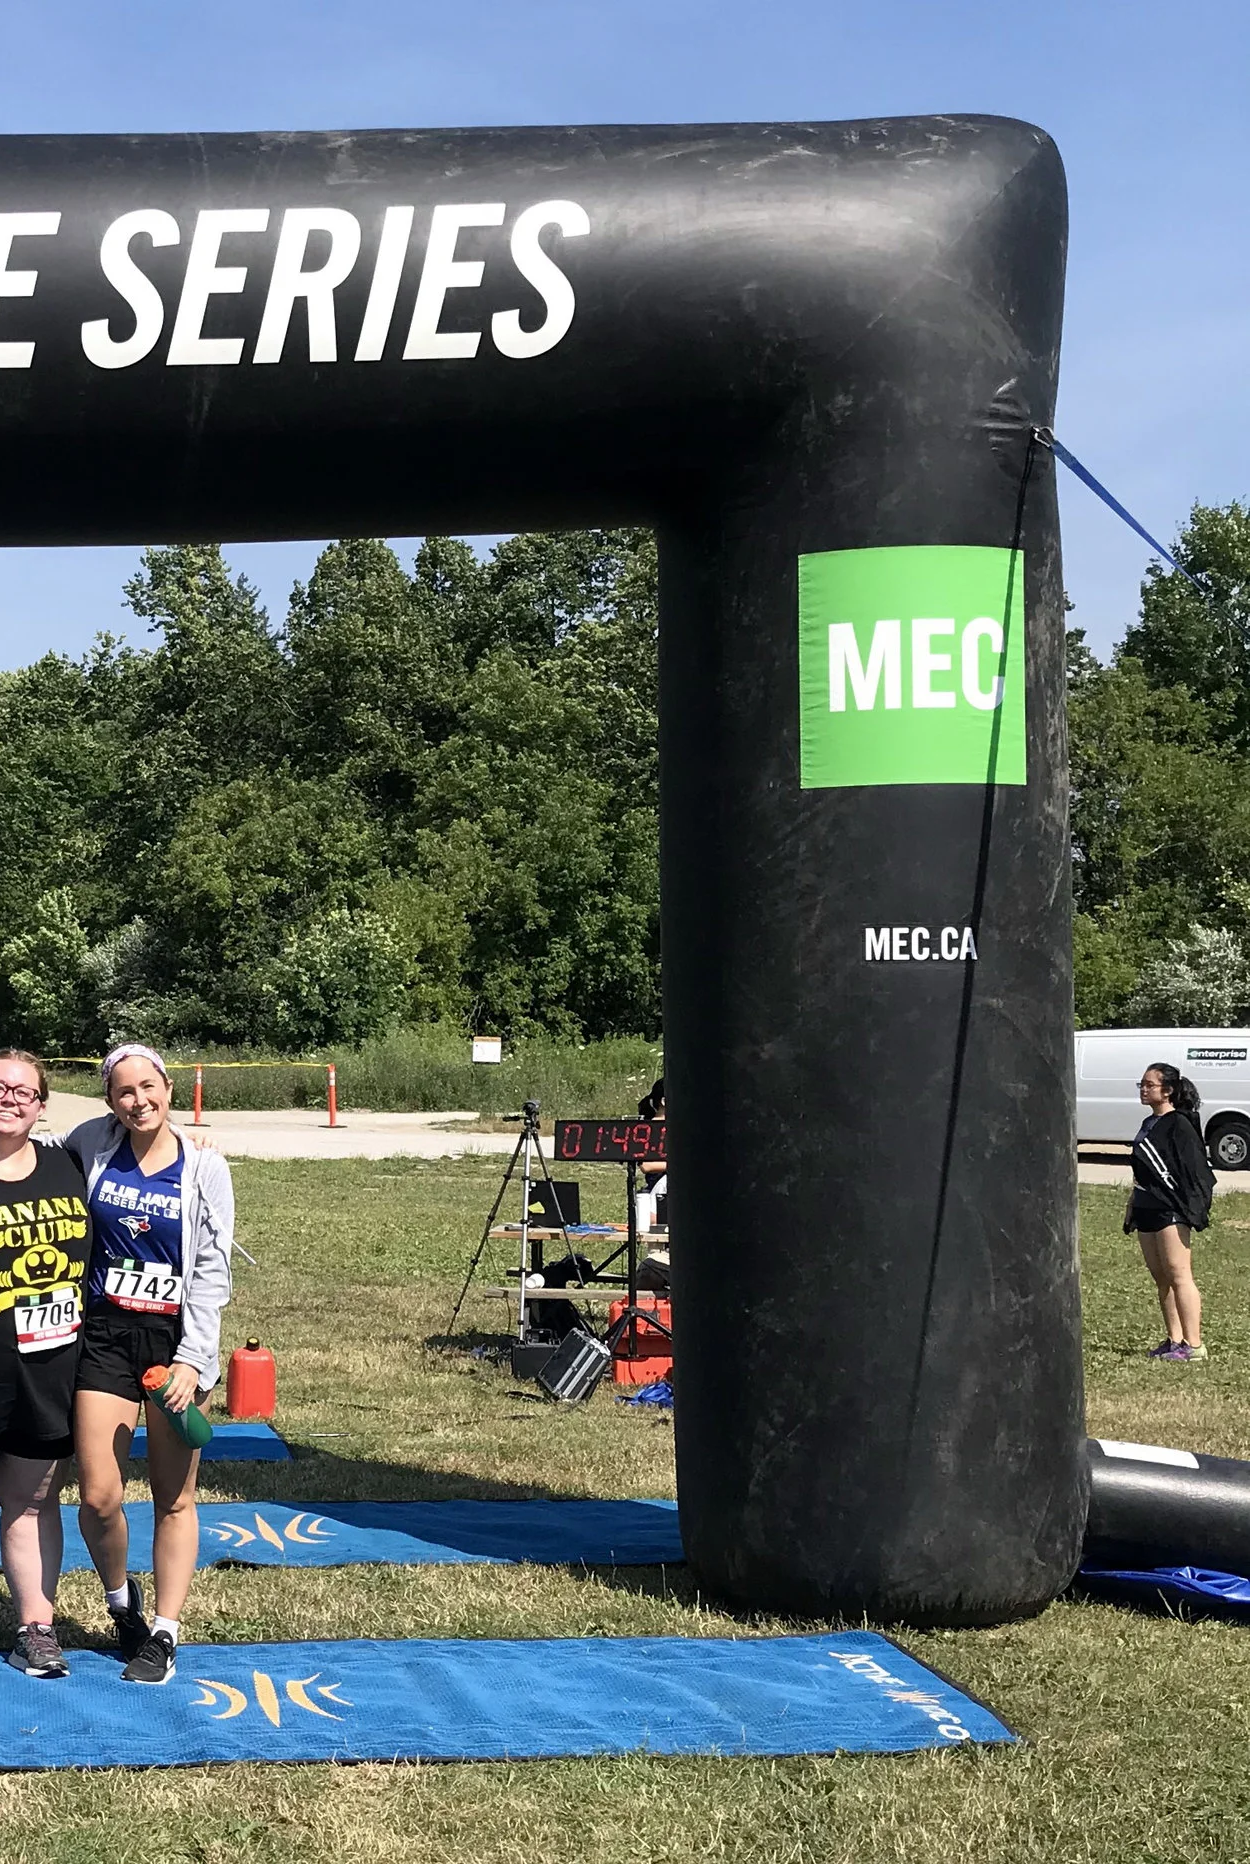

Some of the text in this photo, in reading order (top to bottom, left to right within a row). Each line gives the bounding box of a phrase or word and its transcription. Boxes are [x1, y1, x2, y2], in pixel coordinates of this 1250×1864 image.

[81, 200, 591, 370] SERIES
[828, 616, 1005, 713] MEC
[864, 926, 978, 961] MEC.CA
[1190, 1049, 1246, 1059] enterprise
[98, 1191, 161, 1217] BASEBALL
[101, 1180, 181, 1211] BLUE JAYS
[4, 1219, 74, 1248] CLUB
[113, 1271, 178, 1302] 7742
[21, 1300, 76, 1332] 7709
